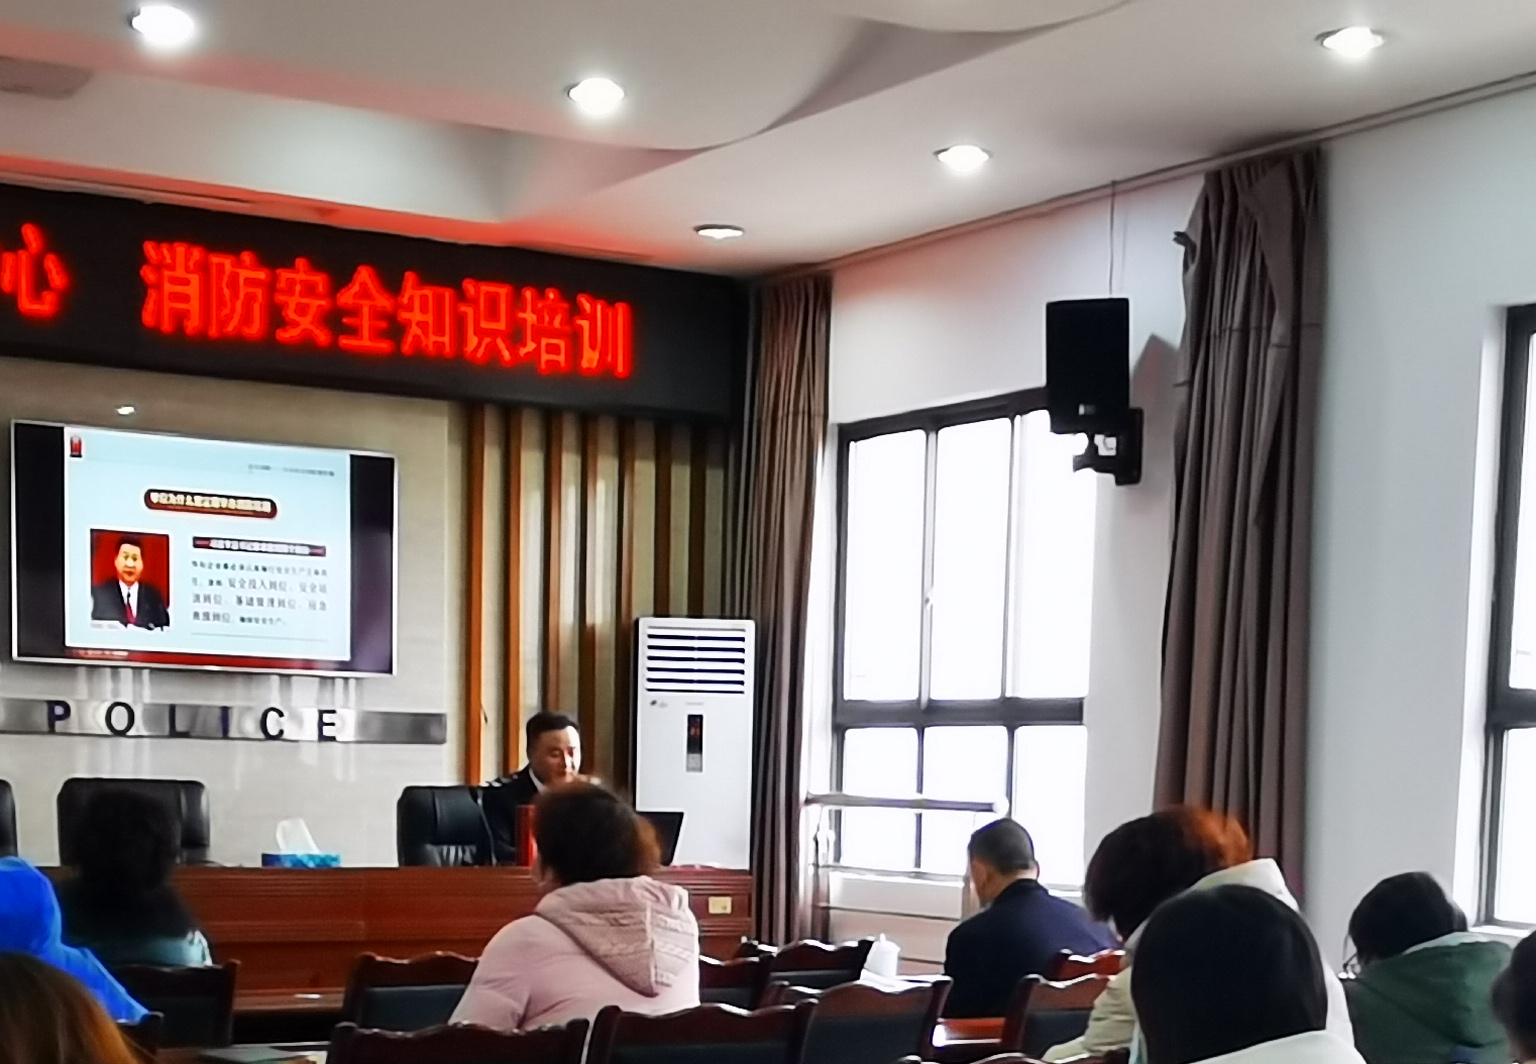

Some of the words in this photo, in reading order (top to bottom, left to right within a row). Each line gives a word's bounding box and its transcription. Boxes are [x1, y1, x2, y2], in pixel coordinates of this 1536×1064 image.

[140, 239, 634, 378] 消防安全知识培训
[46, 699, 337, 742] POLICE
